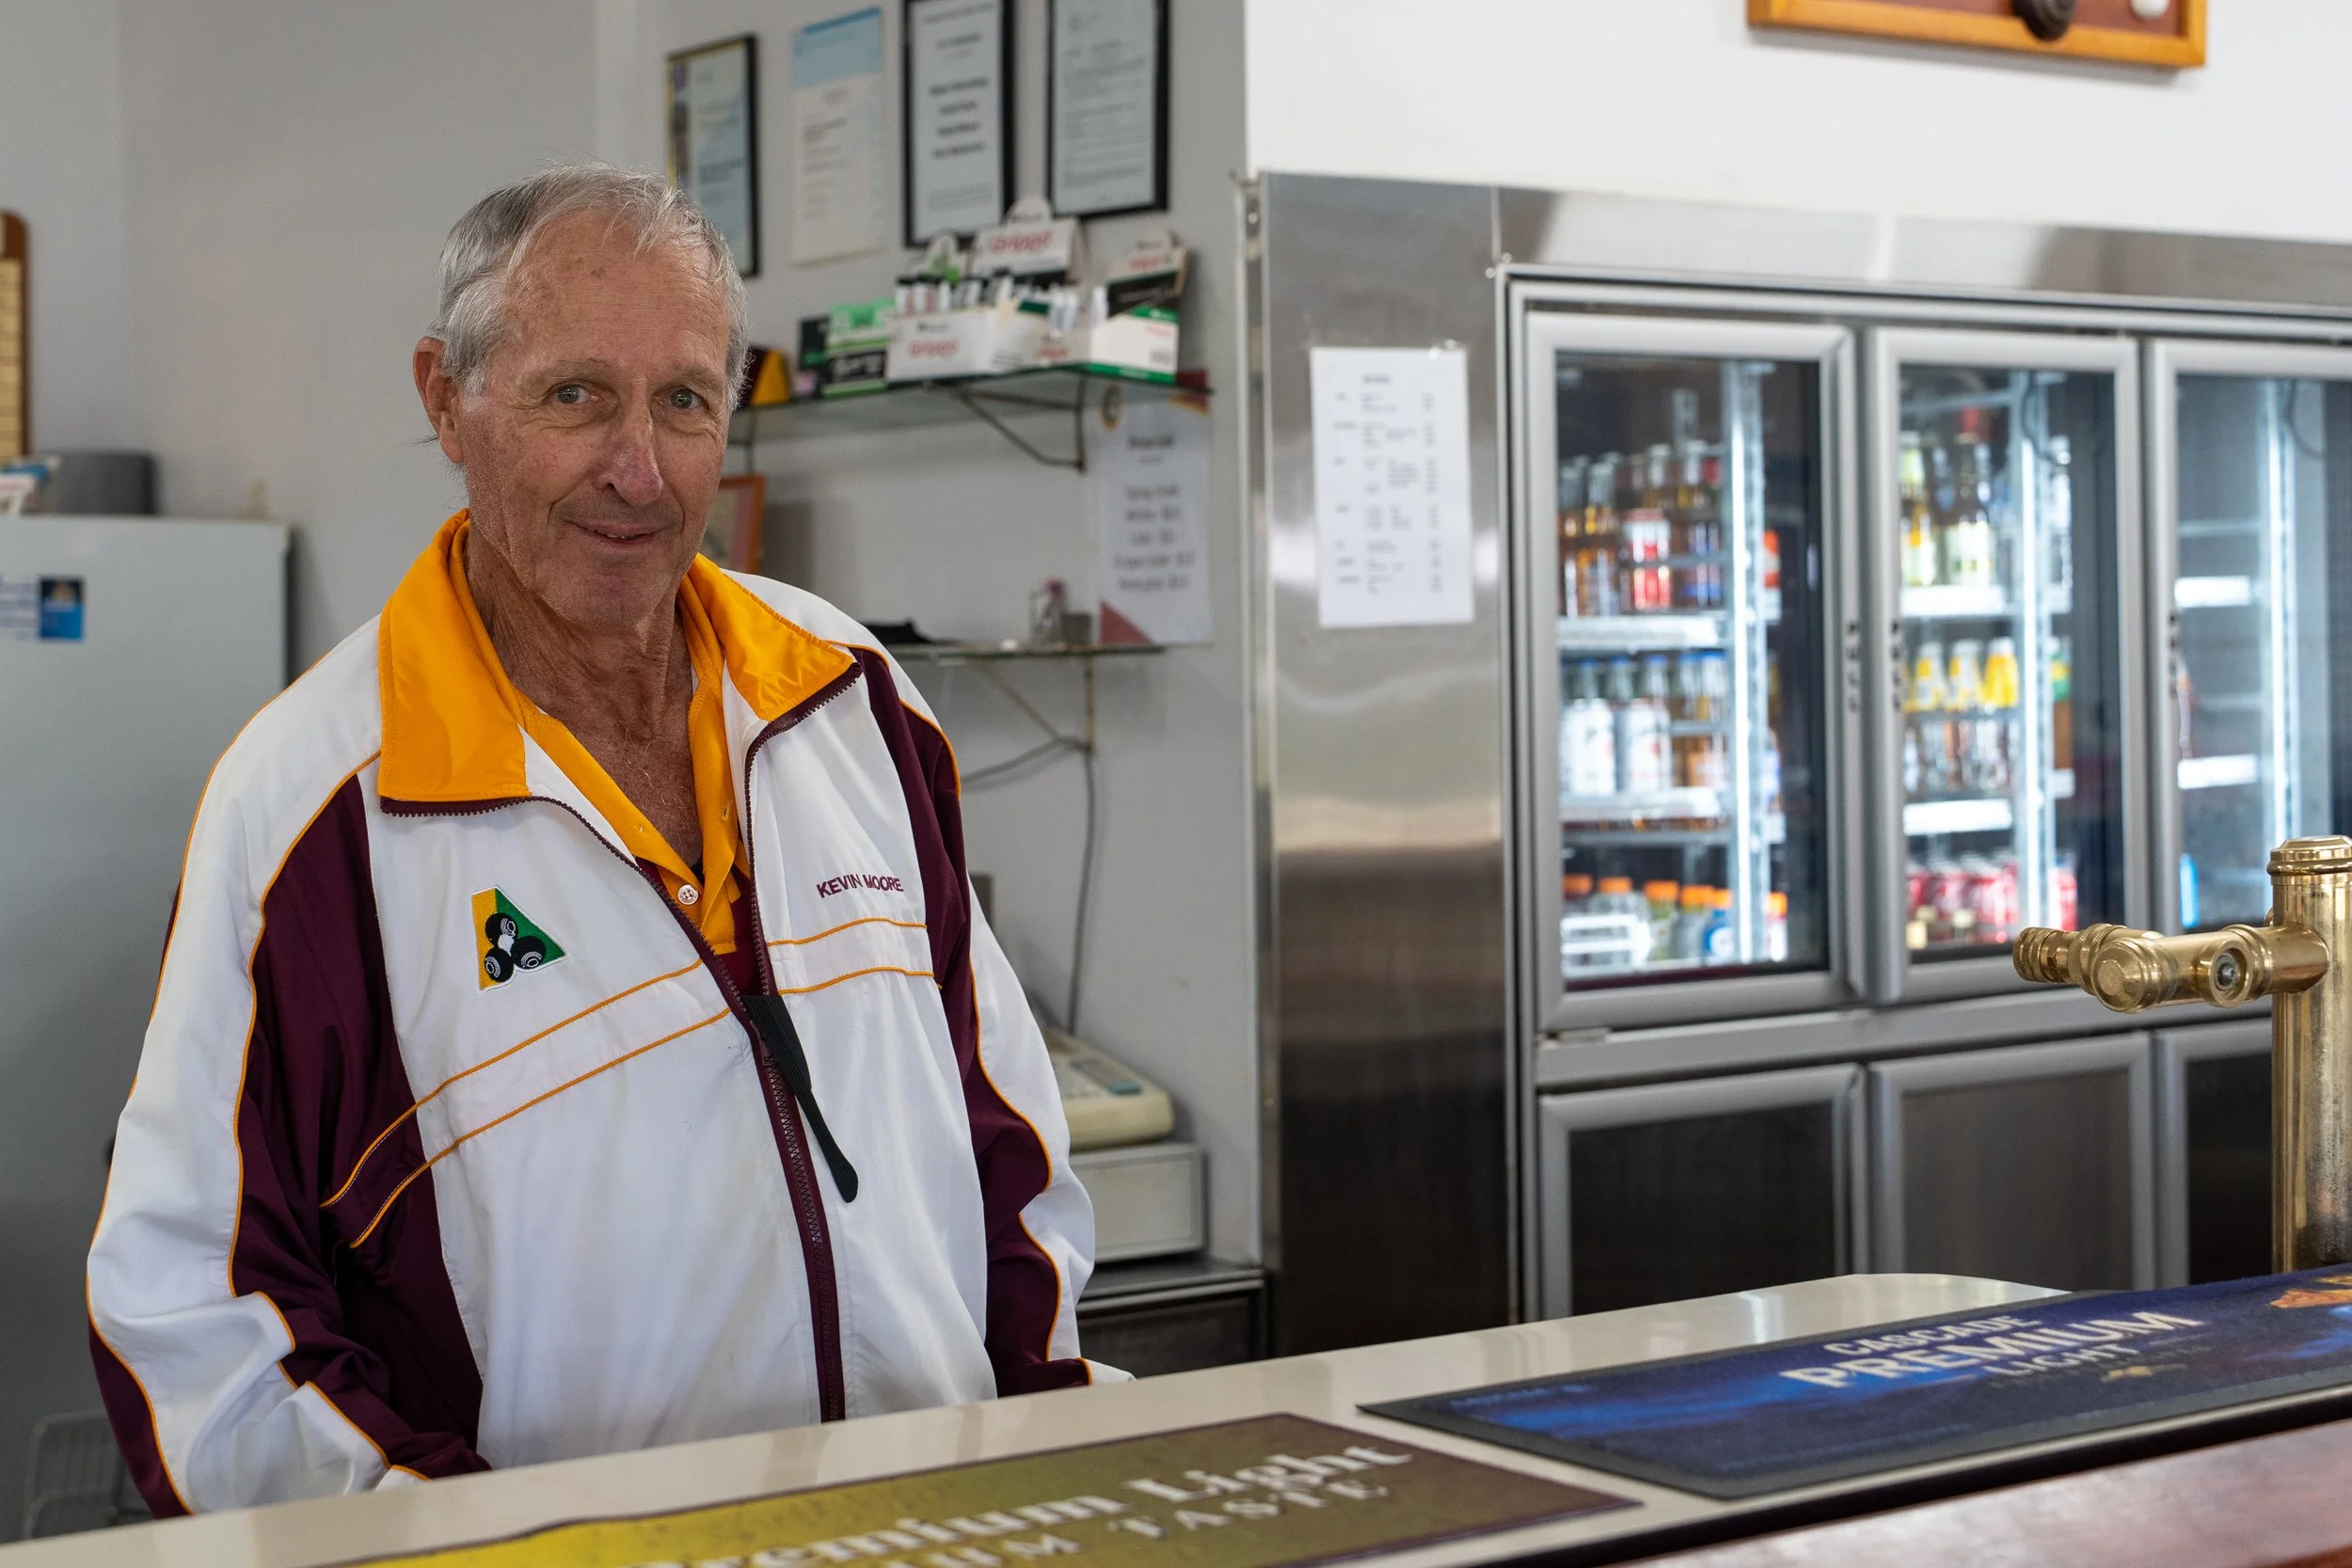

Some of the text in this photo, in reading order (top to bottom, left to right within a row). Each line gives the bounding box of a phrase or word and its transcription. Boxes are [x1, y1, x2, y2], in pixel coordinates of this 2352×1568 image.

[816, 873, 903, 898] KEVIN MOORE
[1778, 1311, 2205, 1388] PREMIUM
[1822, 1316, 2042, 1355] CASCADE
[1982, 1343, 2141, 1376] LIGHT
[621, 1446, 1412, 1568] remium Light
[1107, 1480, 1391, 1539] TASTE
